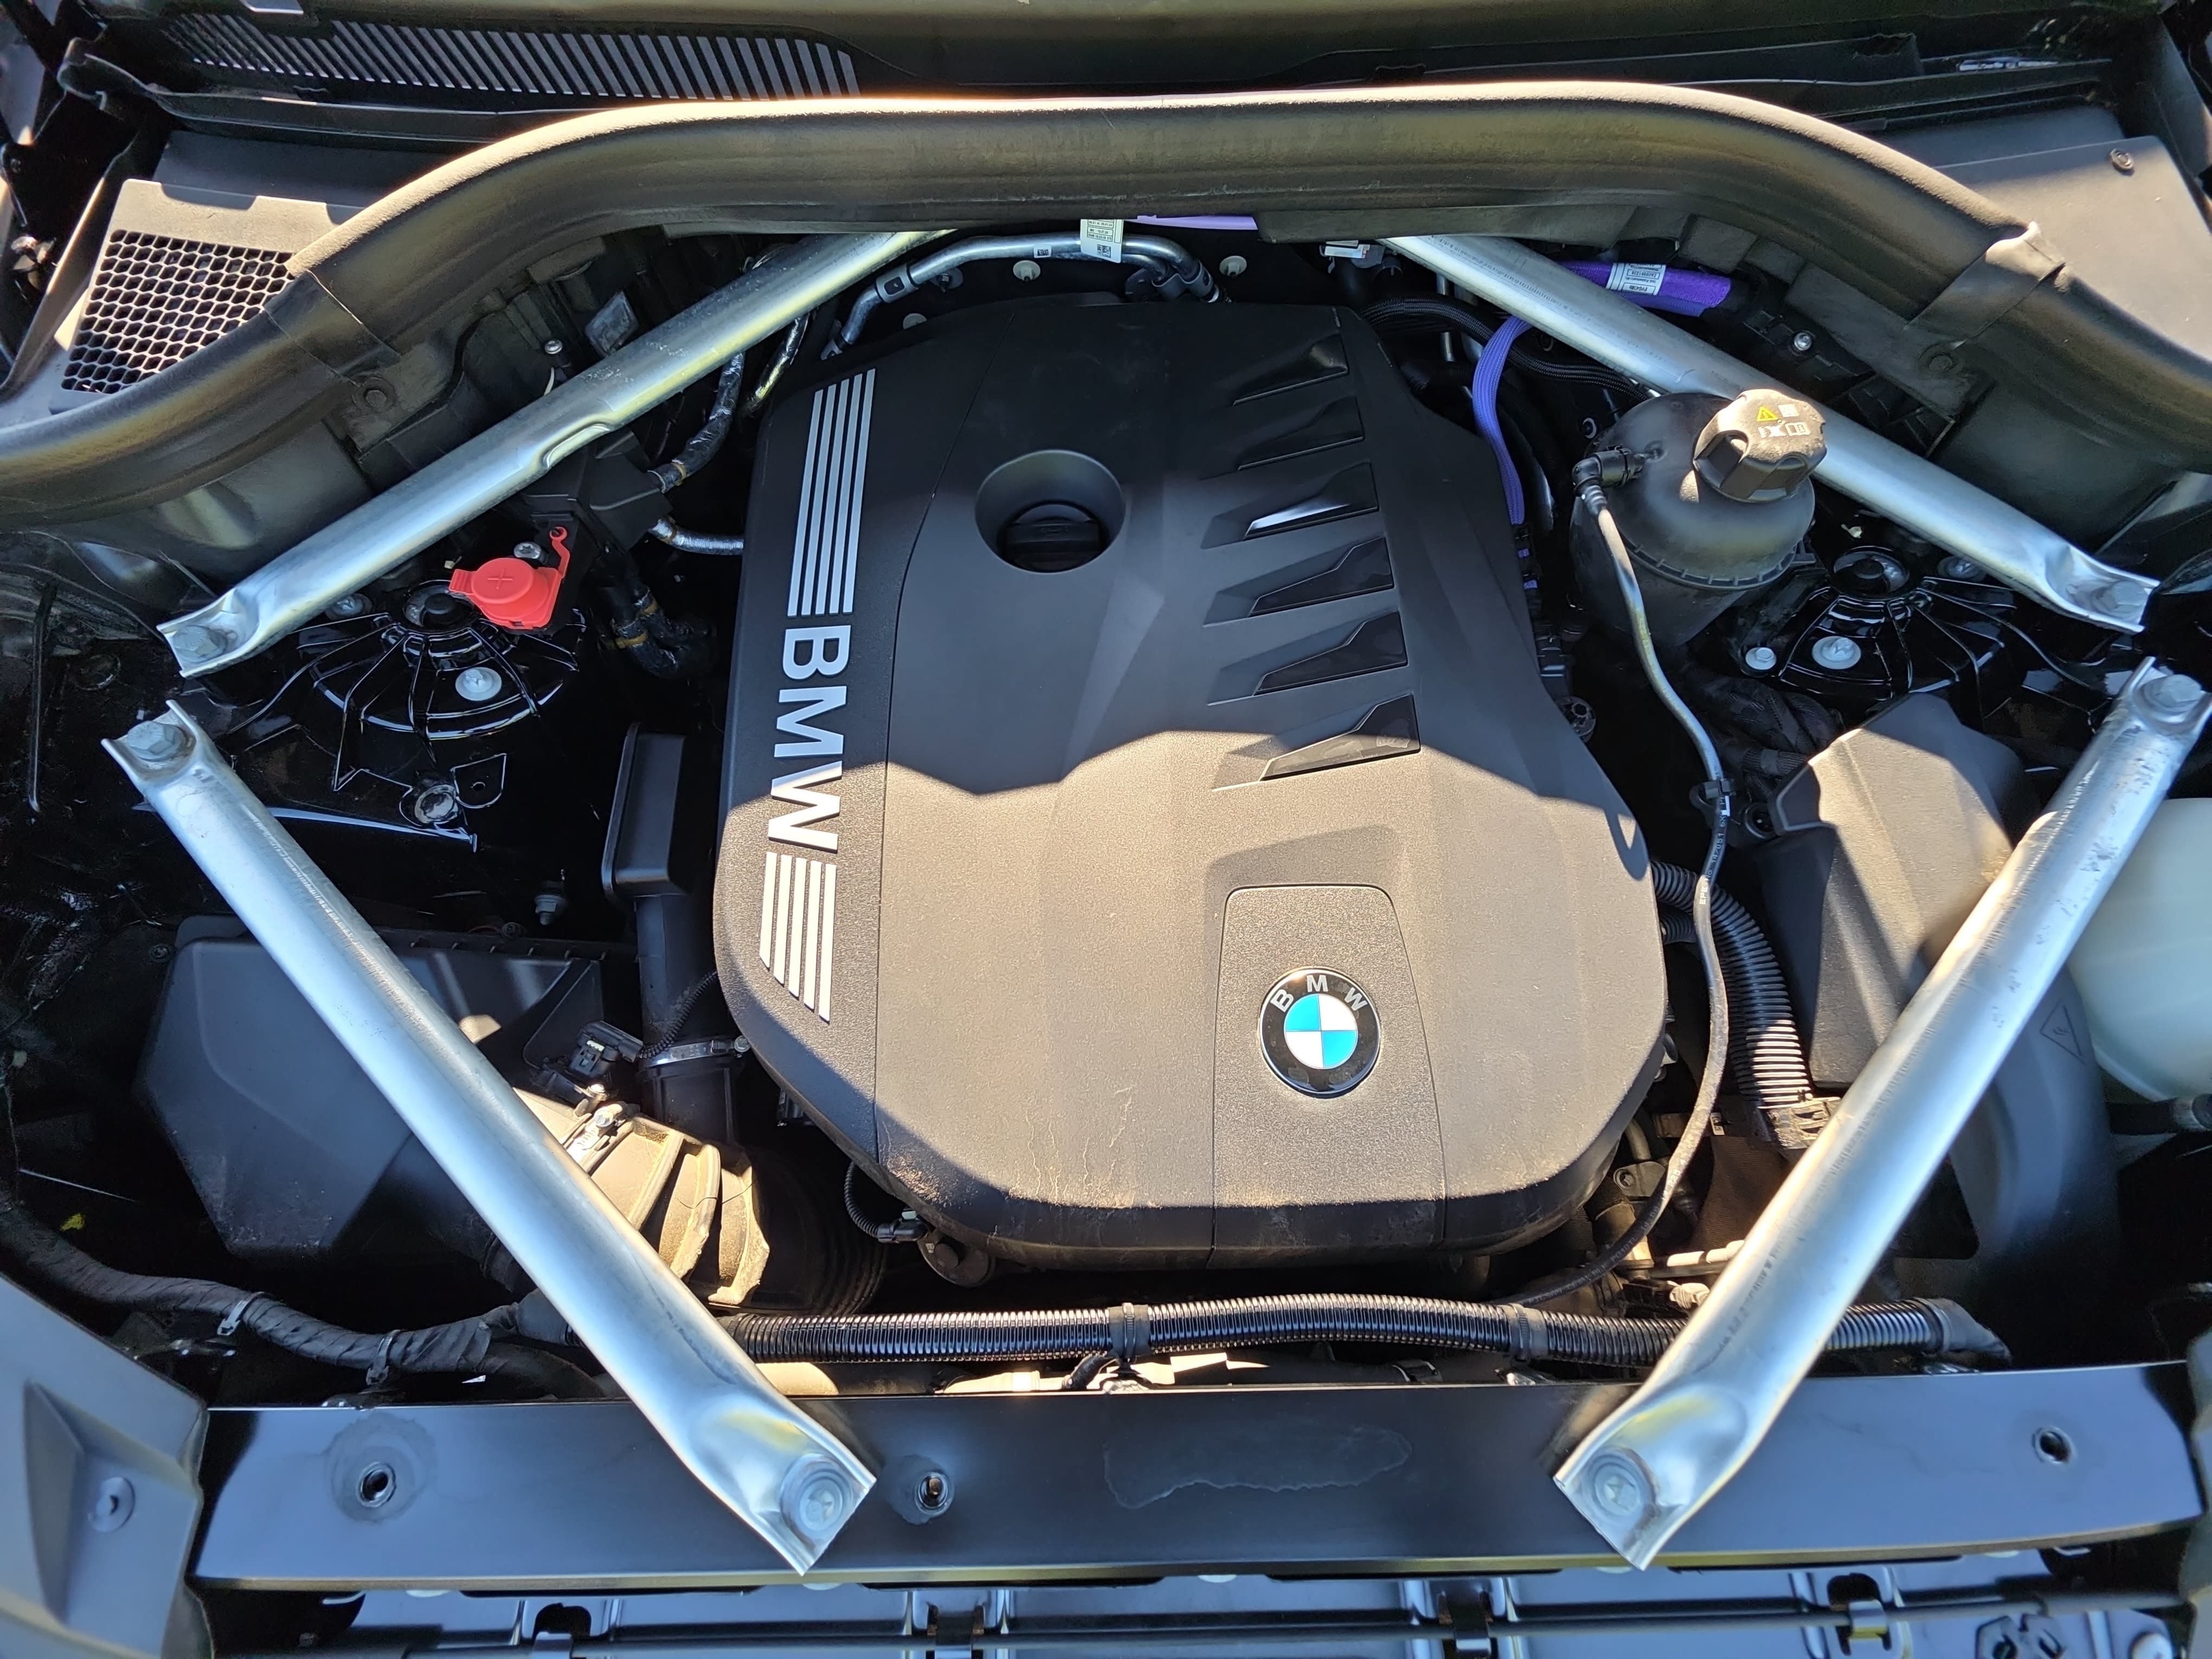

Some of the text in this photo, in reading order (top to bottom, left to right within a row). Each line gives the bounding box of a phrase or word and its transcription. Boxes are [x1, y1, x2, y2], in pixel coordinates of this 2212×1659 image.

[768, 625, 851, 853] BMW
[1698, 886, 1709, 905] EPE
[1270, 975, 1368, 1013] BMW
